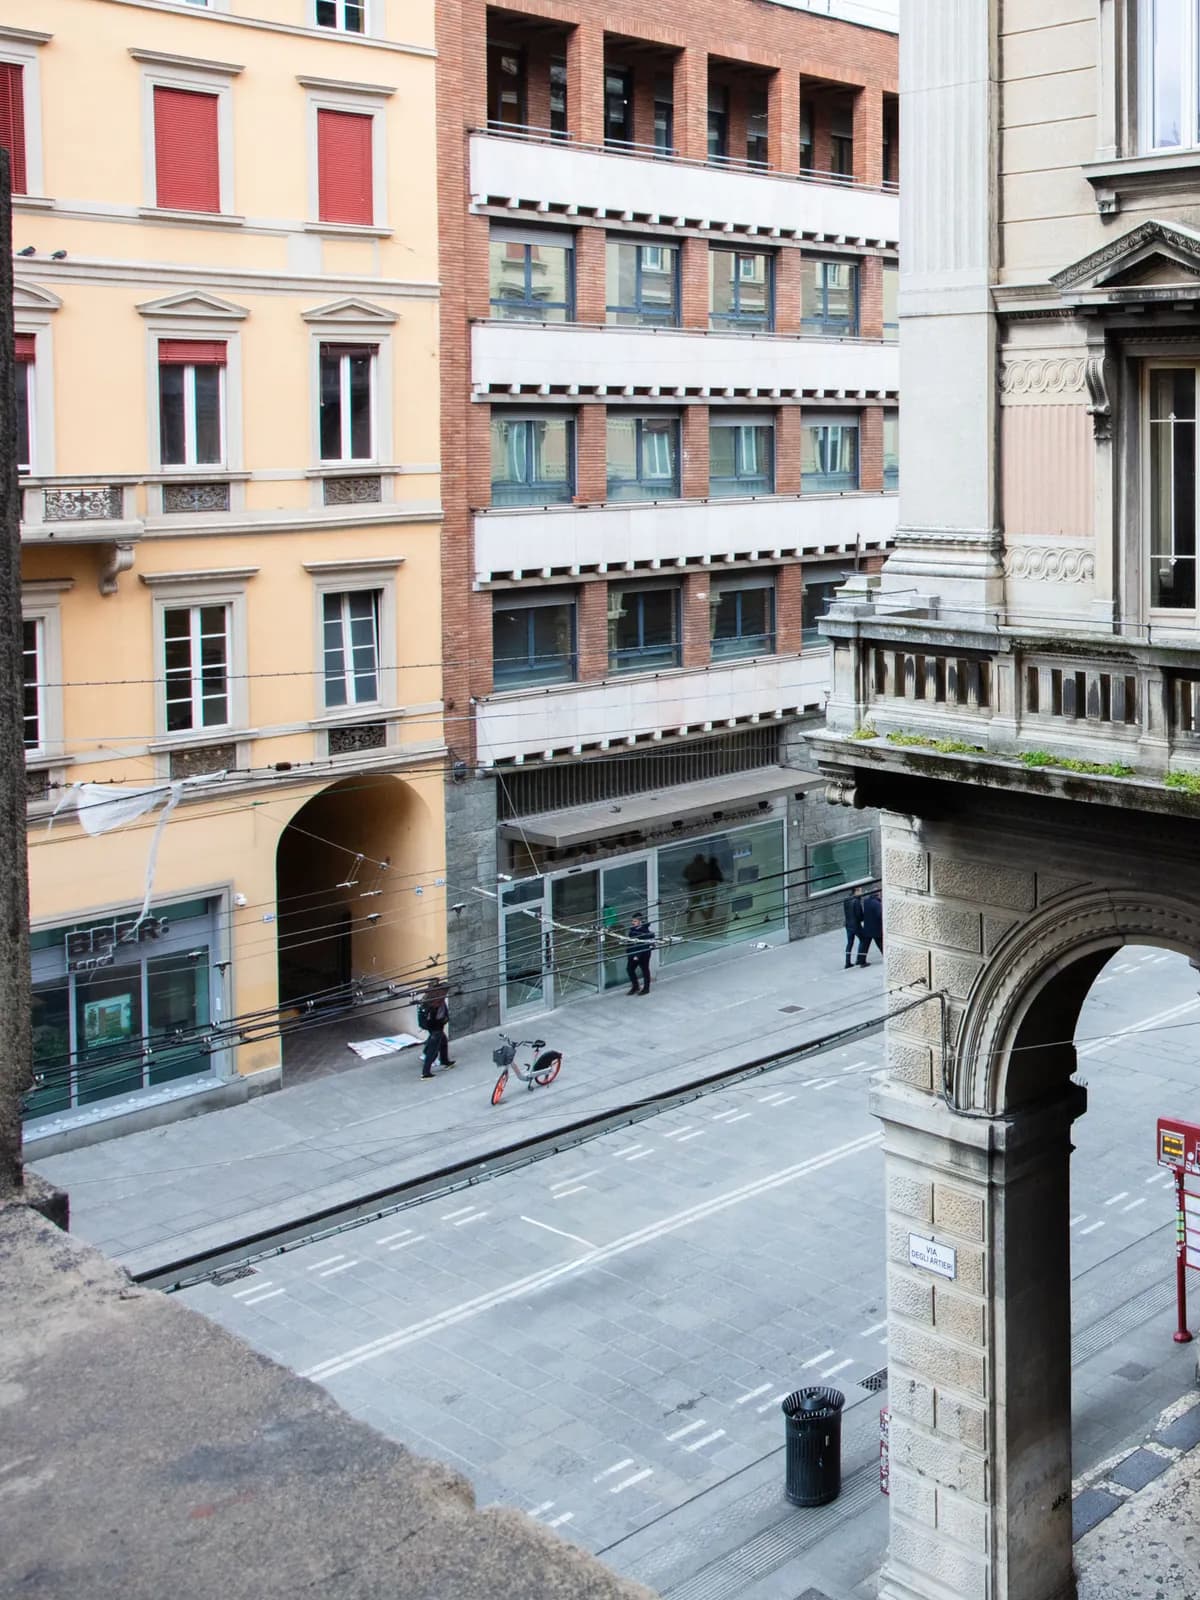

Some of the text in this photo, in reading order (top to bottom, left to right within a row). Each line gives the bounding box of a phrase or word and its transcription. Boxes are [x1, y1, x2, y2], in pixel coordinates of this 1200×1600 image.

[926, 1246, 938, 1256] VIA
[911, 1249, 953, 1271] DEGLI ARTIERI
